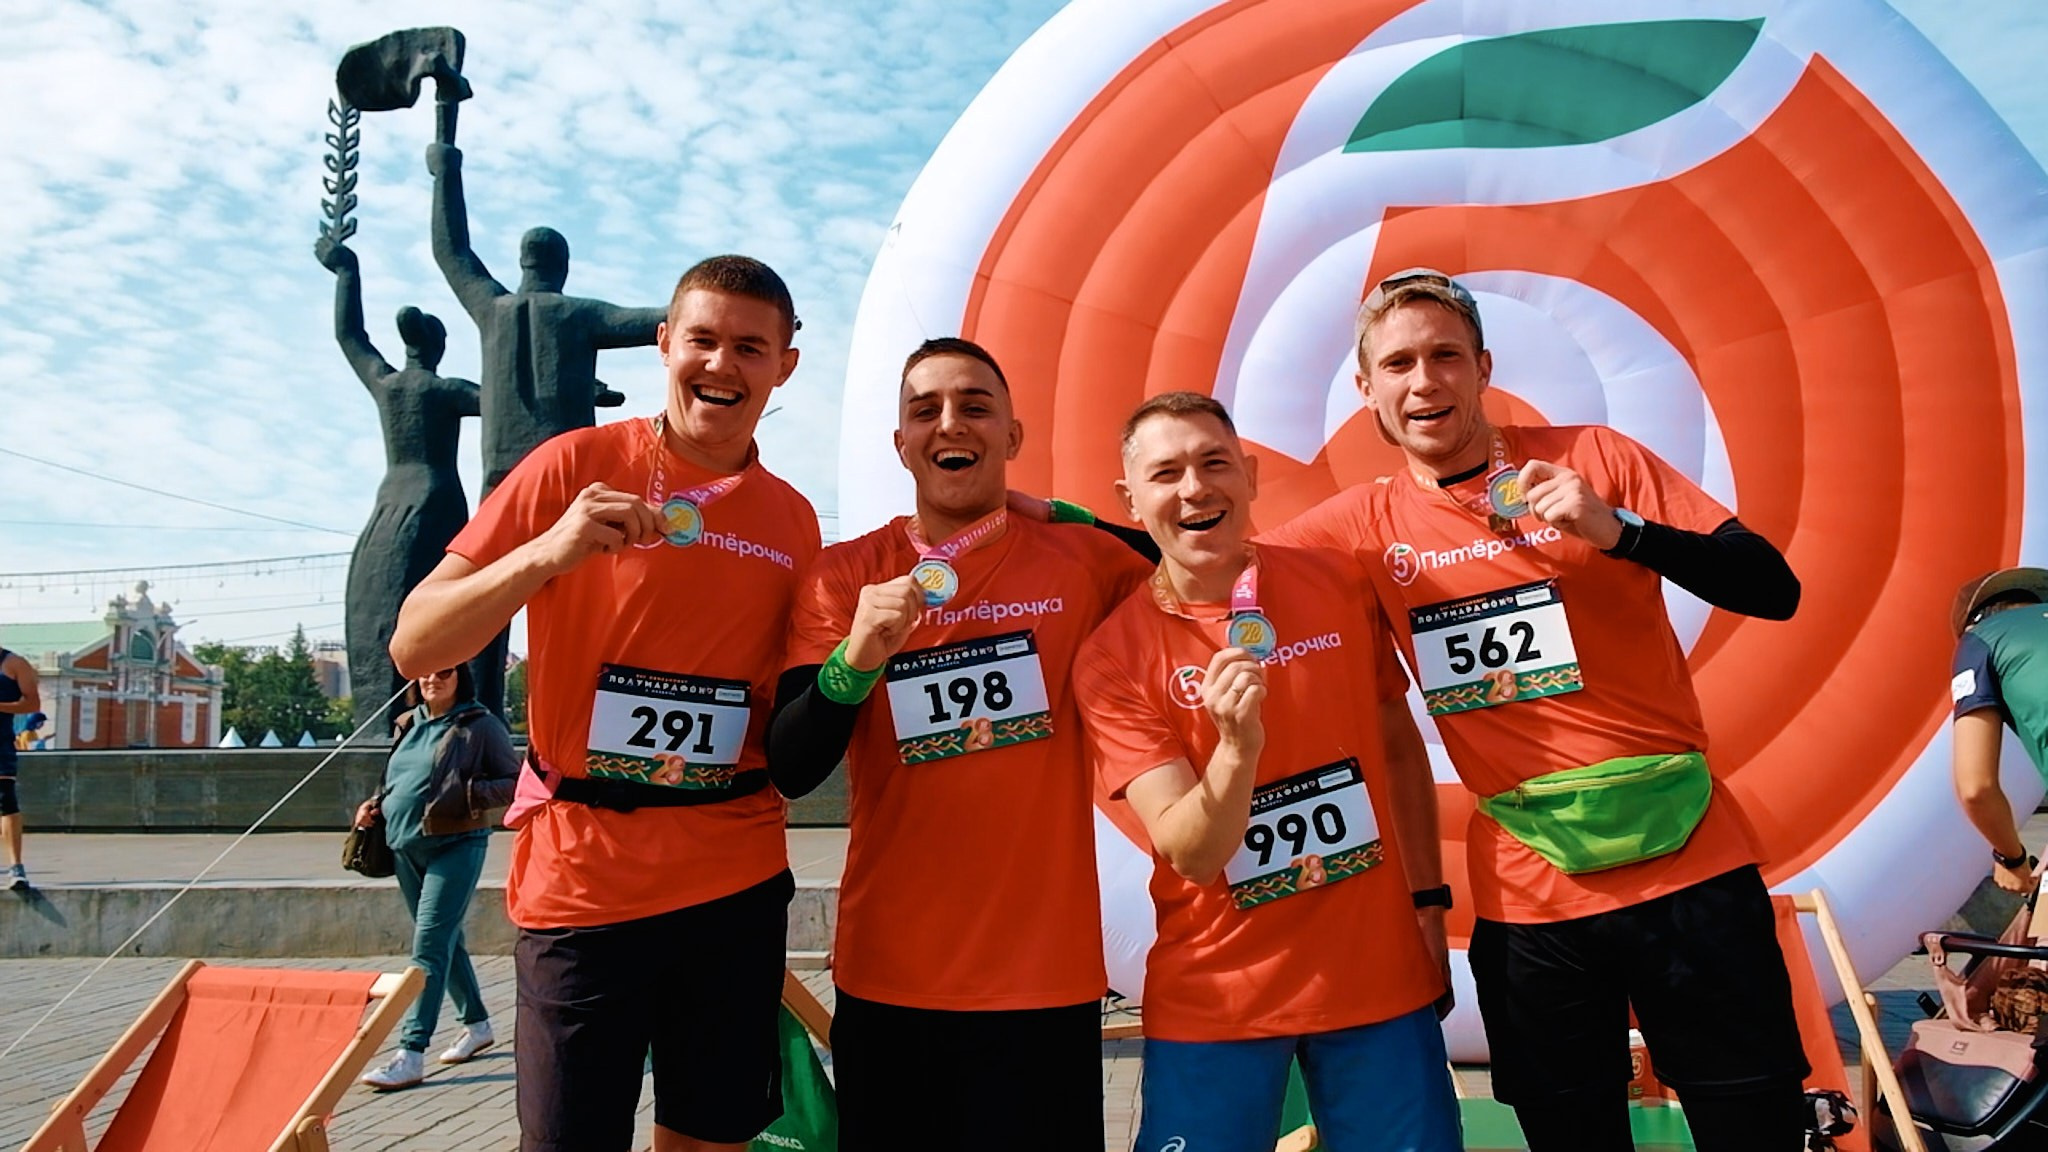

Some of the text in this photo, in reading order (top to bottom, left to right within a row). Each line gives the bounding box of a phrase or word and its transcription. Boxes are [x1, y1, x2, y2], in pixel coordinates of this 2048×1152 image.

[699, 531, 793, 570] тёрочка
[1420, 526, 1562, 572] Пятёрочка
[925, 597, 1064, 626] Пятёрочка
[1444, 621, 1542, 675] 562
[924, 670, 1013, 724] 198
[626, 705, 715, 755] 291
[1251, 782, 1310, 806] МАРАФОН
[1244, 802, 1347, 867] 990
